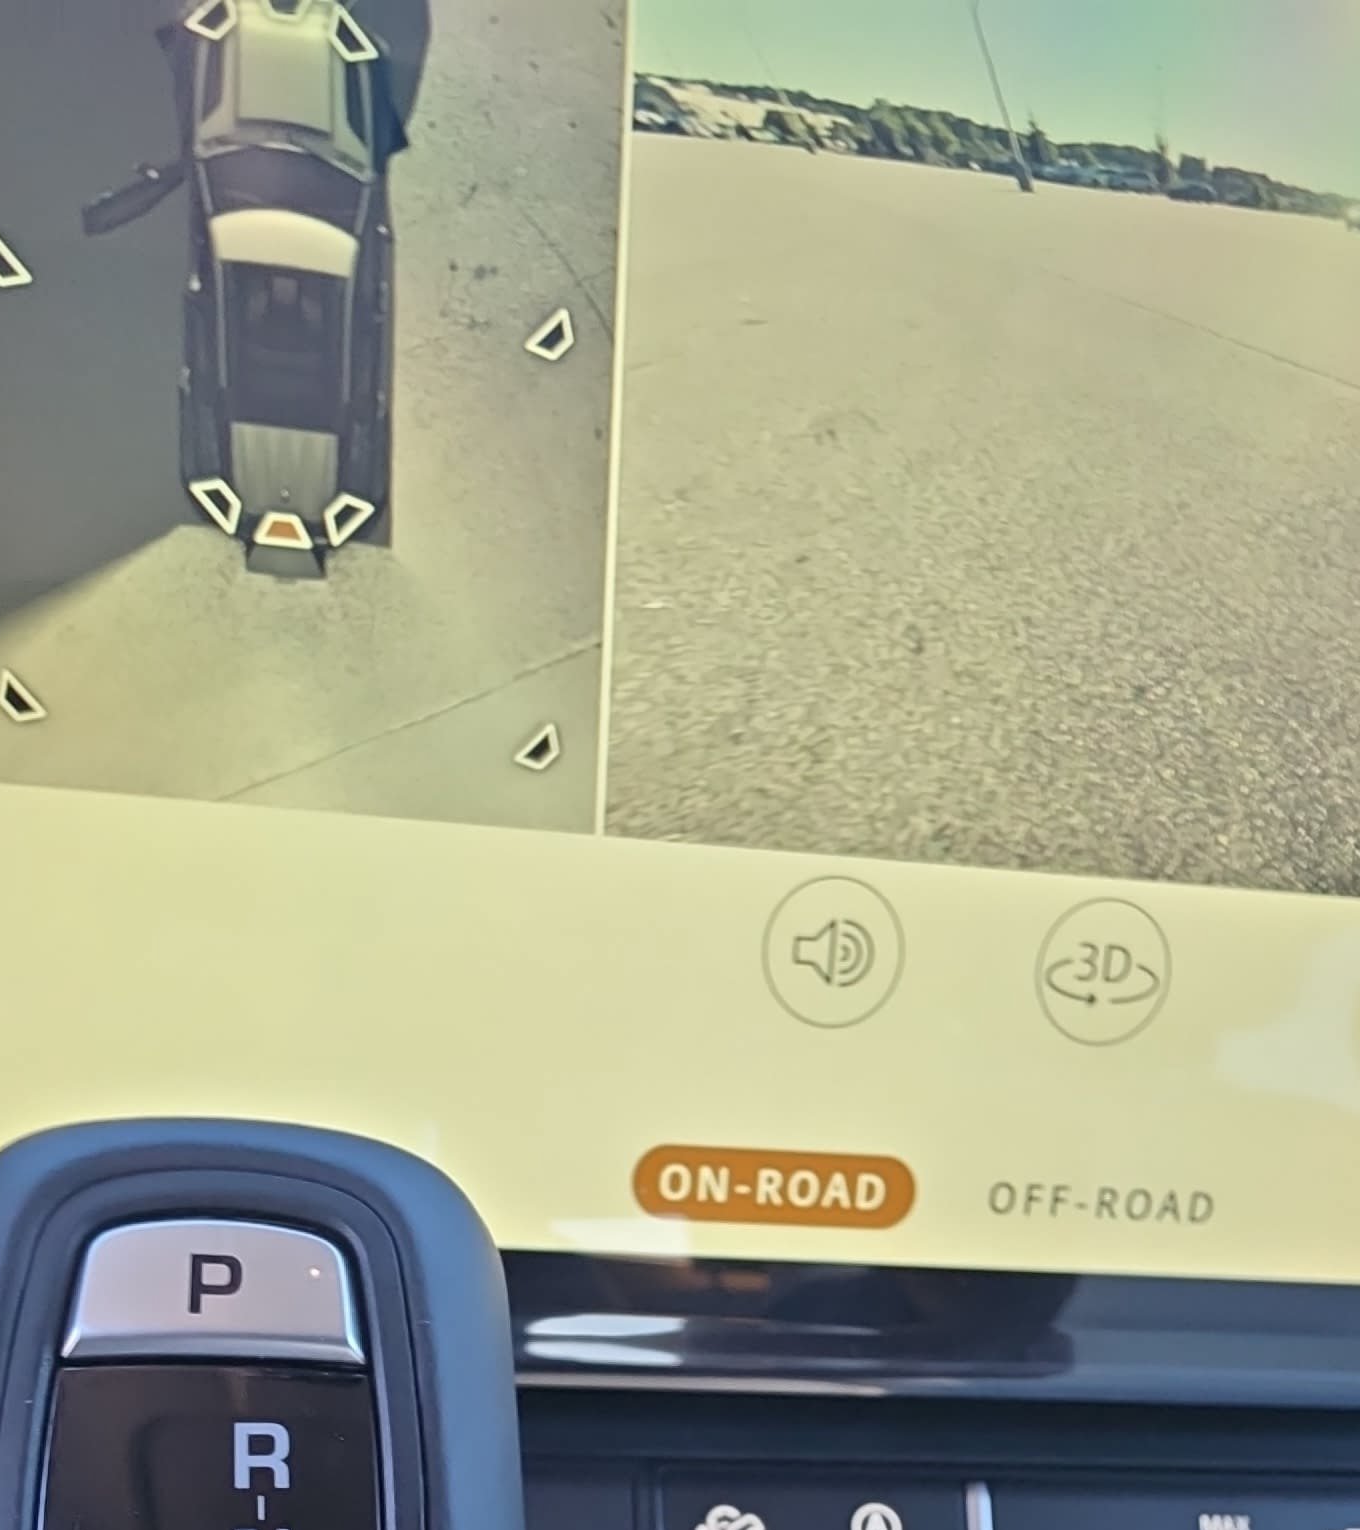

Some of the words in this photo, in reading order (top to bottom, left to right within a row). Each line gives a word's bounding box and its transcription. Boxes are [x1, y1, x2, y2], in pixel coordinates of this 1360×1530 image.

[1074, 940, 1133, 986] 3D
[657, 1162, 889, 1213] ON-ROAD
[987, 1180, 1217, 1226] OFF-ROAD
[187, 1252, 244, 1314] P
[233, 1421, 291, 1490] R
